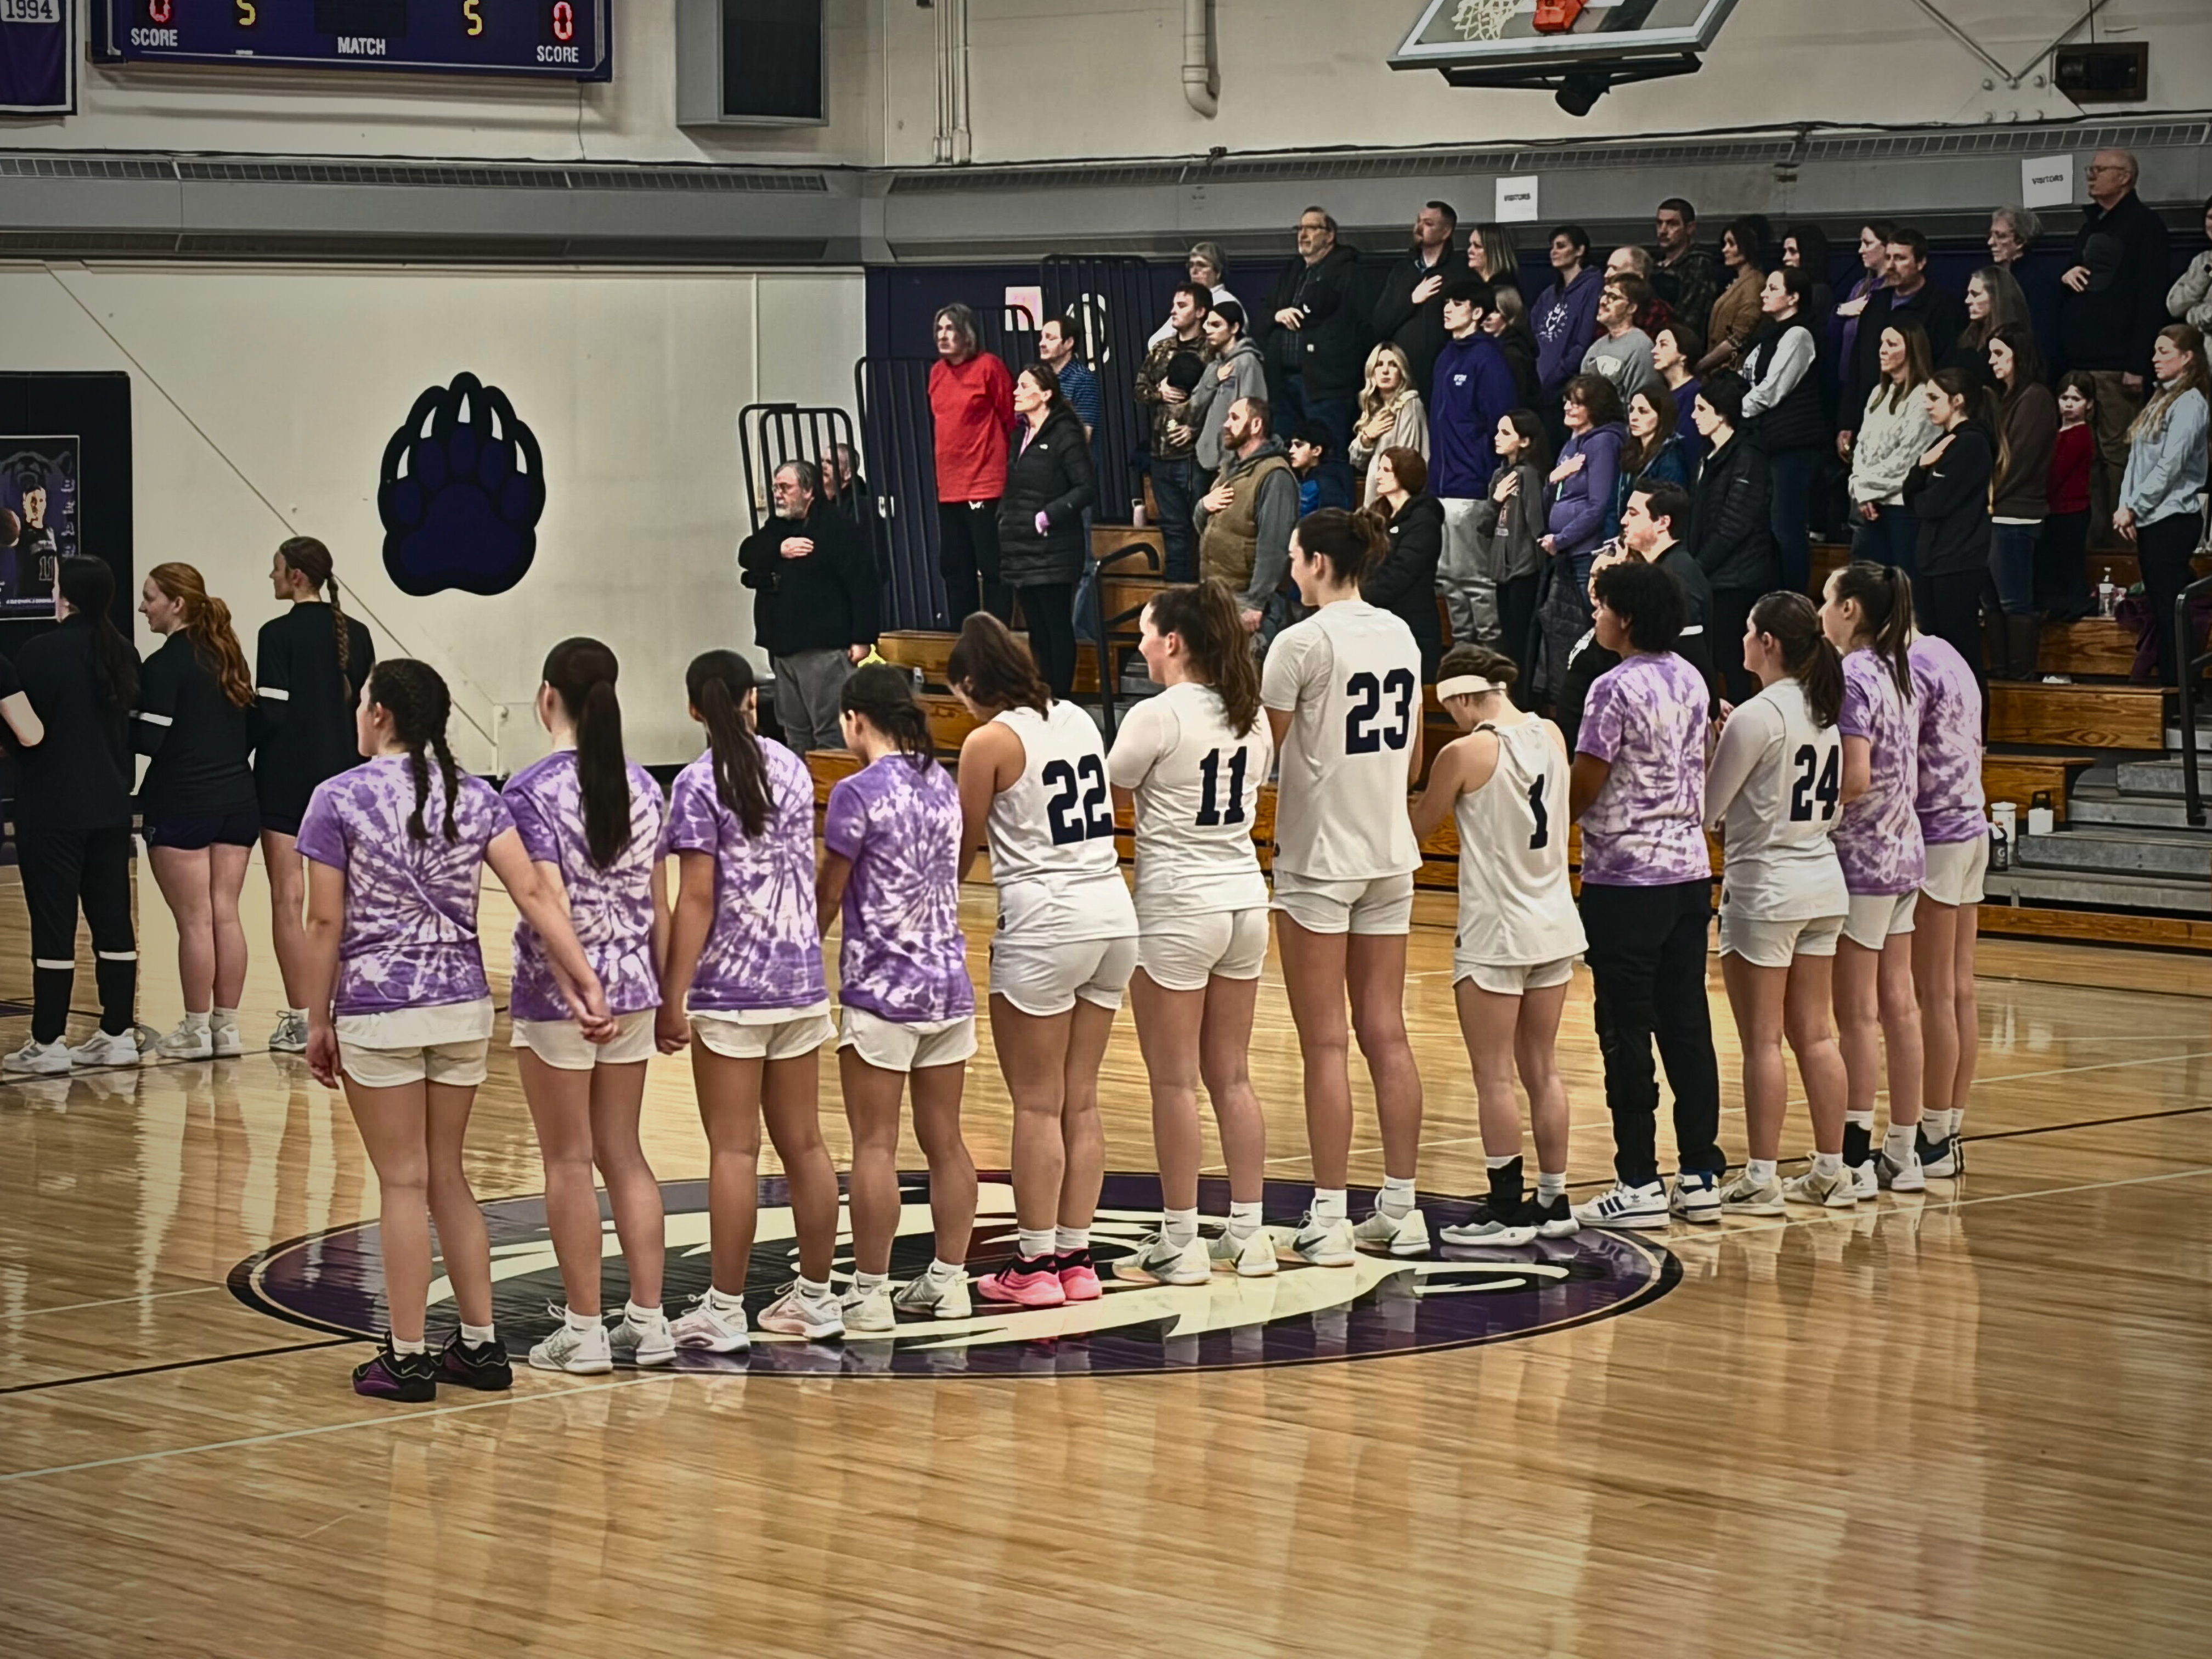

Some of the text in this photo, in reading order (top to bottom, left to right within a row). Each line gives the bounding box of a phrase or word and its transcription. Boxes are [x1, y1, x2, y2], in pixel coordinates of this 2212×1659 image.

[7, 0, 53, 19] 1994
[464, 0, 482, 35] 5
[553, 1, 572, 40] 0
[131, 28, 178, 47] SCORE
[337, 37, 385, 55] MATCH
[537, 46, 579, 63] SCORE
[2032, 174, 2064, 185] VISITORS
[1345, 668, 1415, 755] 23
[1042, 753, 1115, 845] 22
[1195, 746, 1248, 826] 11
[1790, 744, 1839, 822] 24
[1527, 774, 1548, 850] 1
